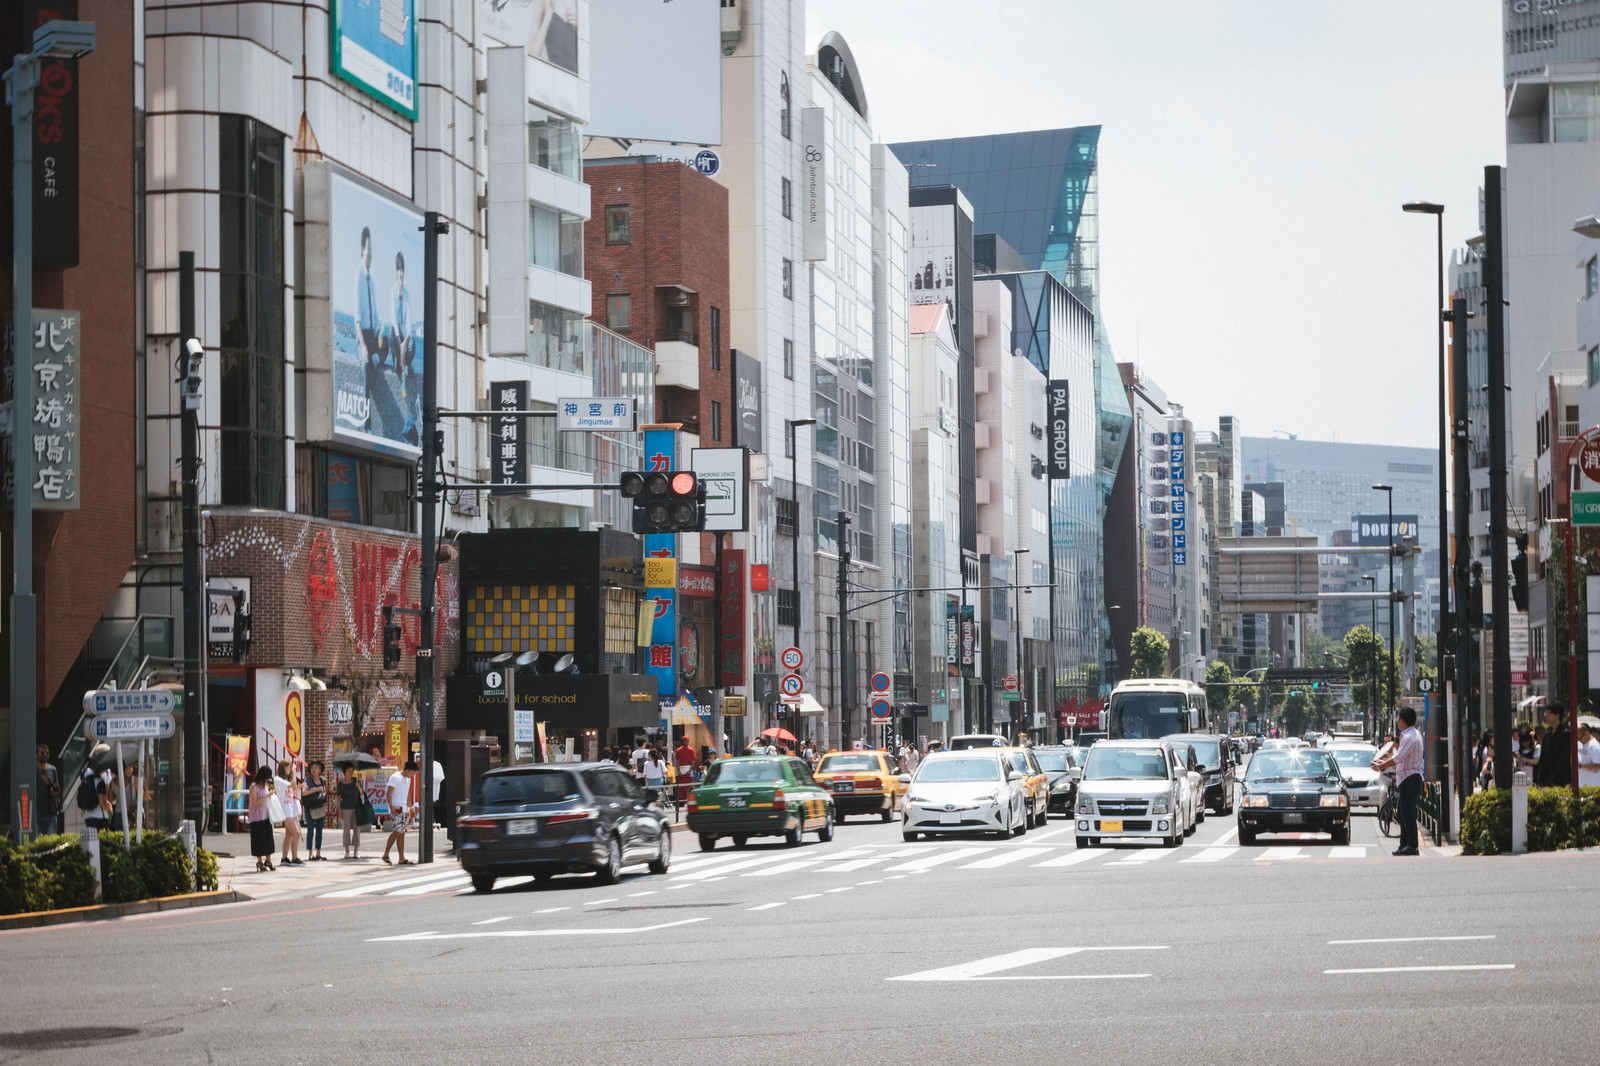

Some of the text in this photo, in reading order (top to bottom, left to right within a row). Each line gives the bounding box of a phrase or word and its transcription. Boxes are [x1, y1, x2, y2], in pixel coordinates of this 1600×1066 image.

[44, 157, 58, 198] CAFÉ
[809, 165, 817, 198] Johnbull
[60, 316, 75, 330] 3F
[336, 390, 370, 418] MATCH
[564, 403, 627, 417] 神宮前
[577, 417, 613, 427] Jingumae
[1053, 388, 1067, 470] PAL GROUP
[1584, 450, 1600, 470] 消
[1172, 450, 1185, 564] ダイヤモンド社
[648, 565, 663, 573] cool
[650, 452, 673, 668] カケ館
[648, 577, 672, 585] school
[727, 560, 739, 616] ラーメン
[785, 653, 799, 664] 50
[524, 693, 539, 704] for
[542, 693, 577, 704] school
